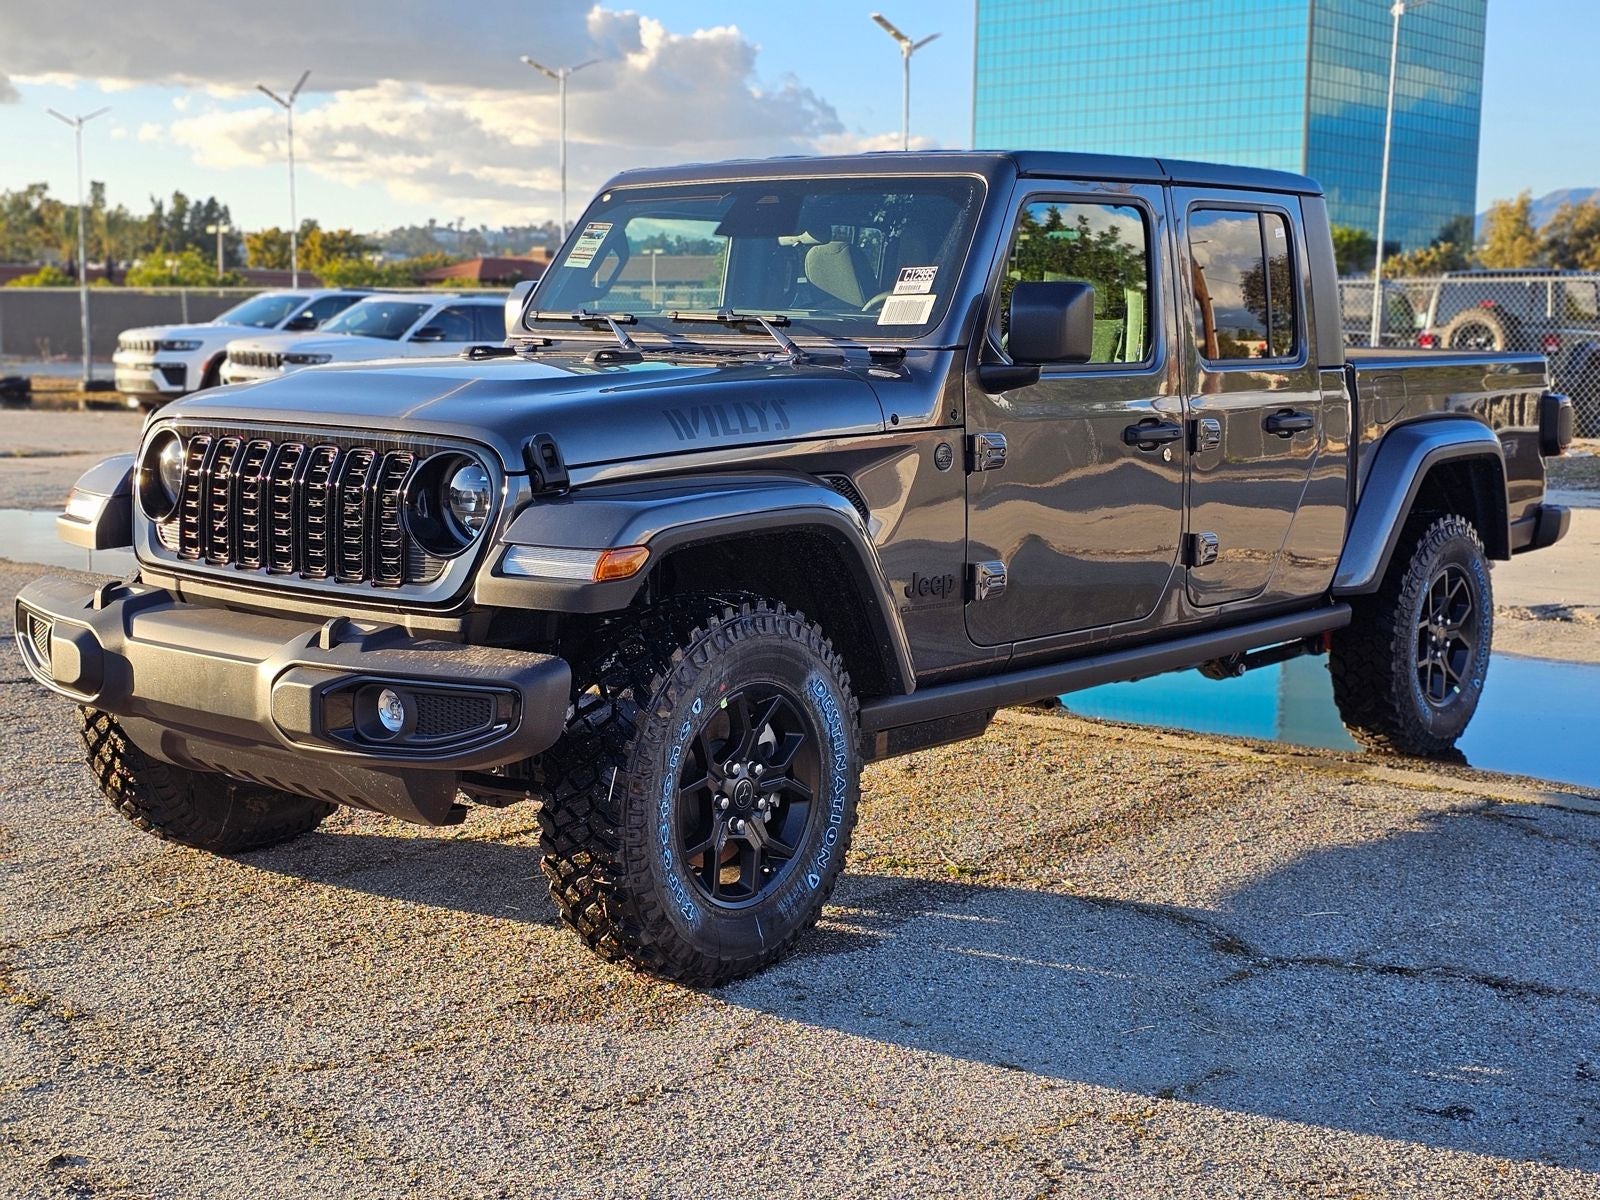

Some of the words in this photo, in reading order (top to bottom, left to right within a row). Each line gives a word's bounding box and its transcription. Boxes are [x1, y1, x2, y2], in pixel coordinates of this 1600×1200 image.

[662, 399, 790, 441] WILLYS
[904, 571, 954, 599] Jeep
[660, 721, 694, 920] Firestone
[812, 679, 847, 869] DESTINATION
